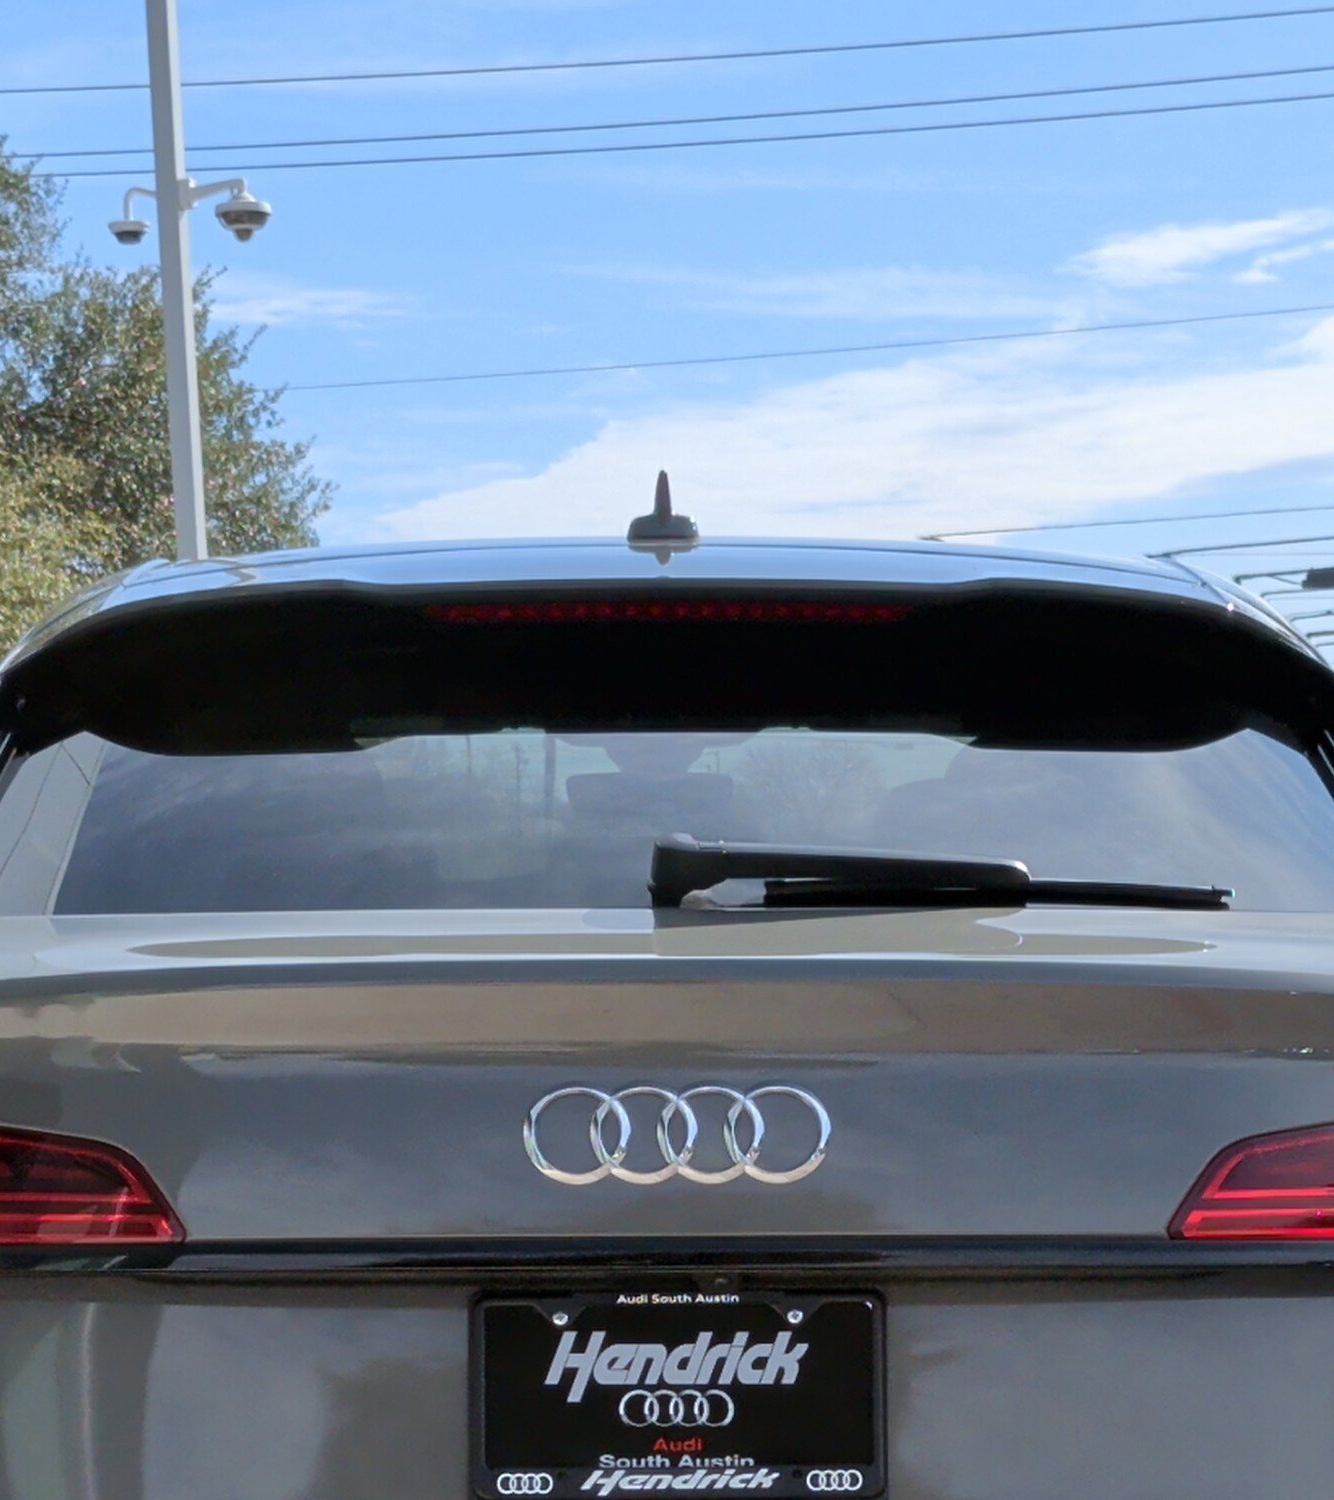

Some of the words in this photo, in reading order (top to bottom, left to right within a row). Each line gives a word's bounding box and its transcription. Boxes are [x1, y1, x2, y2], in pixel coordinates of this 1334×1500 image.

[616, 1294, 649, 1305] Audi
[651, 1293, 692, 1304] South
[695, 1293, 740, 1304] Austin
[544, 1331, 809, 1403] Hendrick
[653, 1437, 703, 1451] Audi
[599, 1454, 670, 1468] South
[678, 1454, 755, 1468] Austin
[580, 1468, 780, 1496] Hendrick
